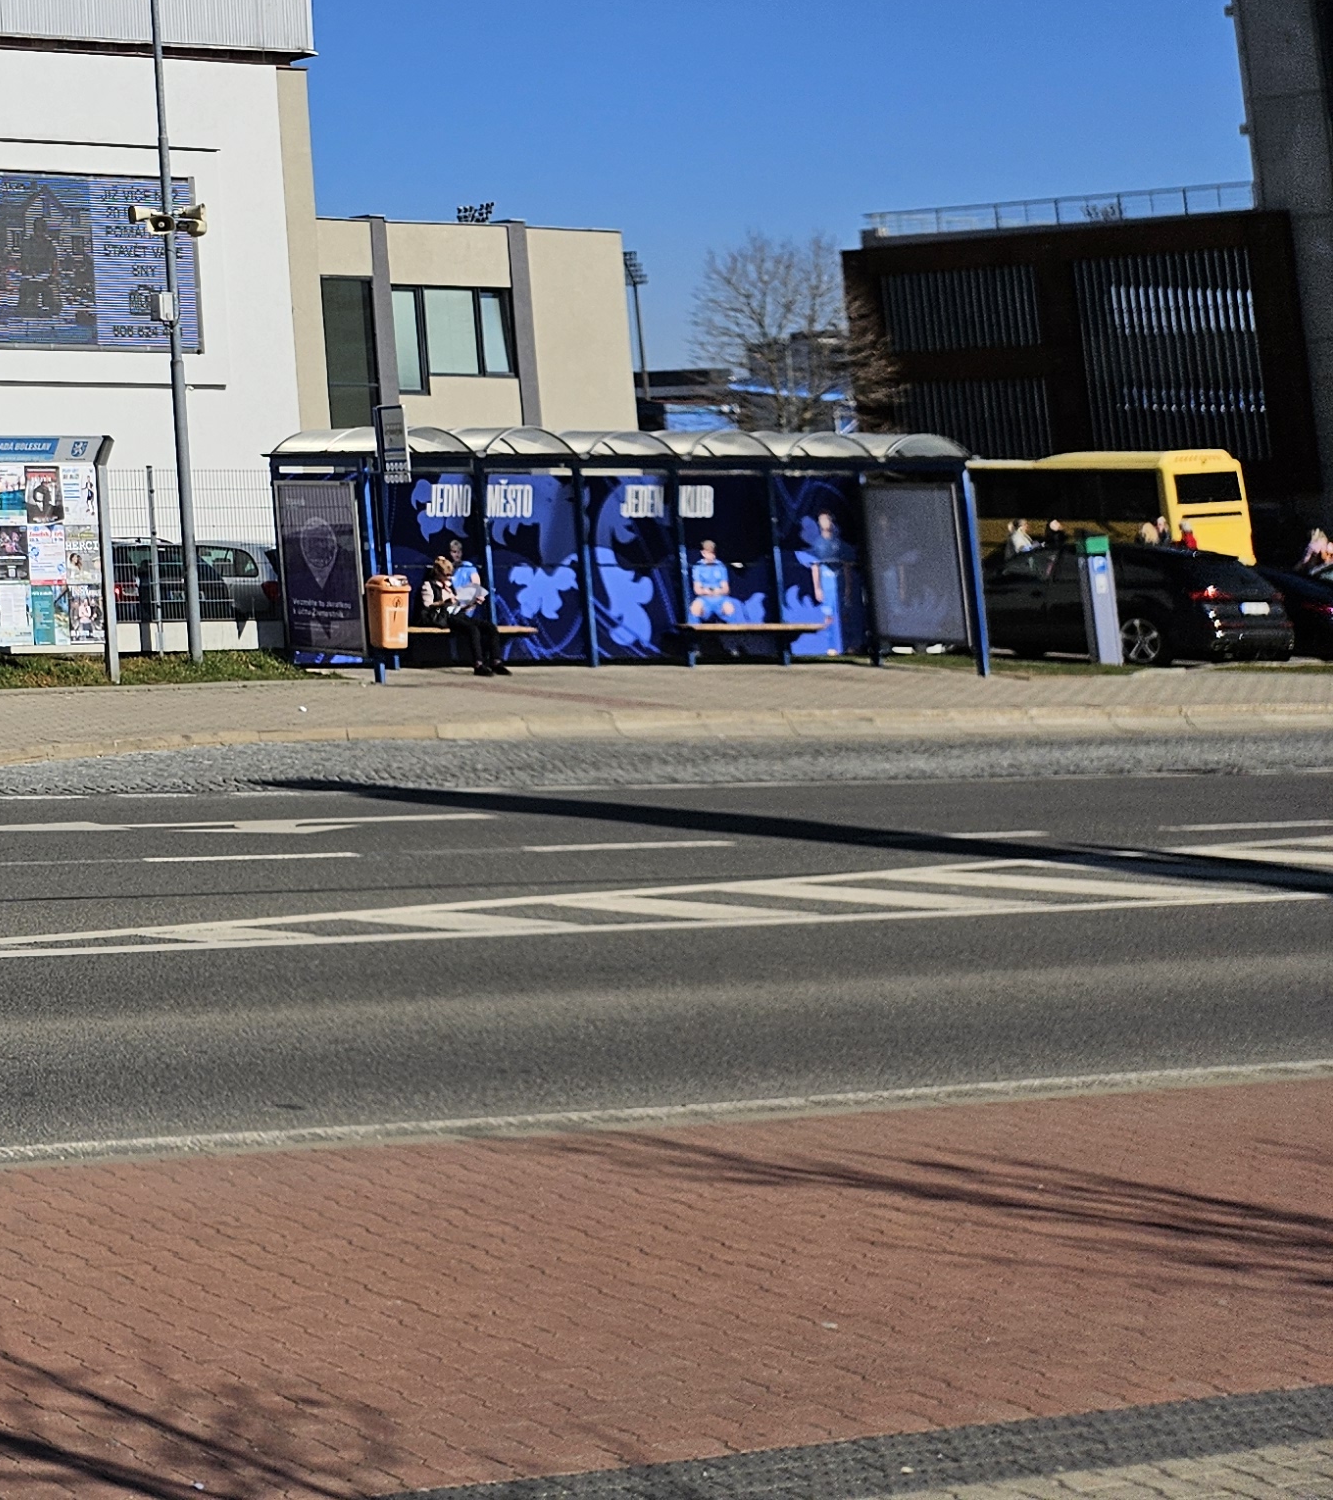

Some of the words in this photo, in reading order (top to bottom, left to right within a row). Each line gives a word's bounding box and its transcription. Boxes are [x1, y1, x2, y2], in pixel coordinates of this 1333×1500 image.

[14, 441, 52, 452] BOLESLAV
[426, 484, 472, 518] JEDNO
[487, 479, 533, 518] MĚSTO
[620, 484, 665, 518] JEDEN
[678, 484, 715, 519] KLUB
